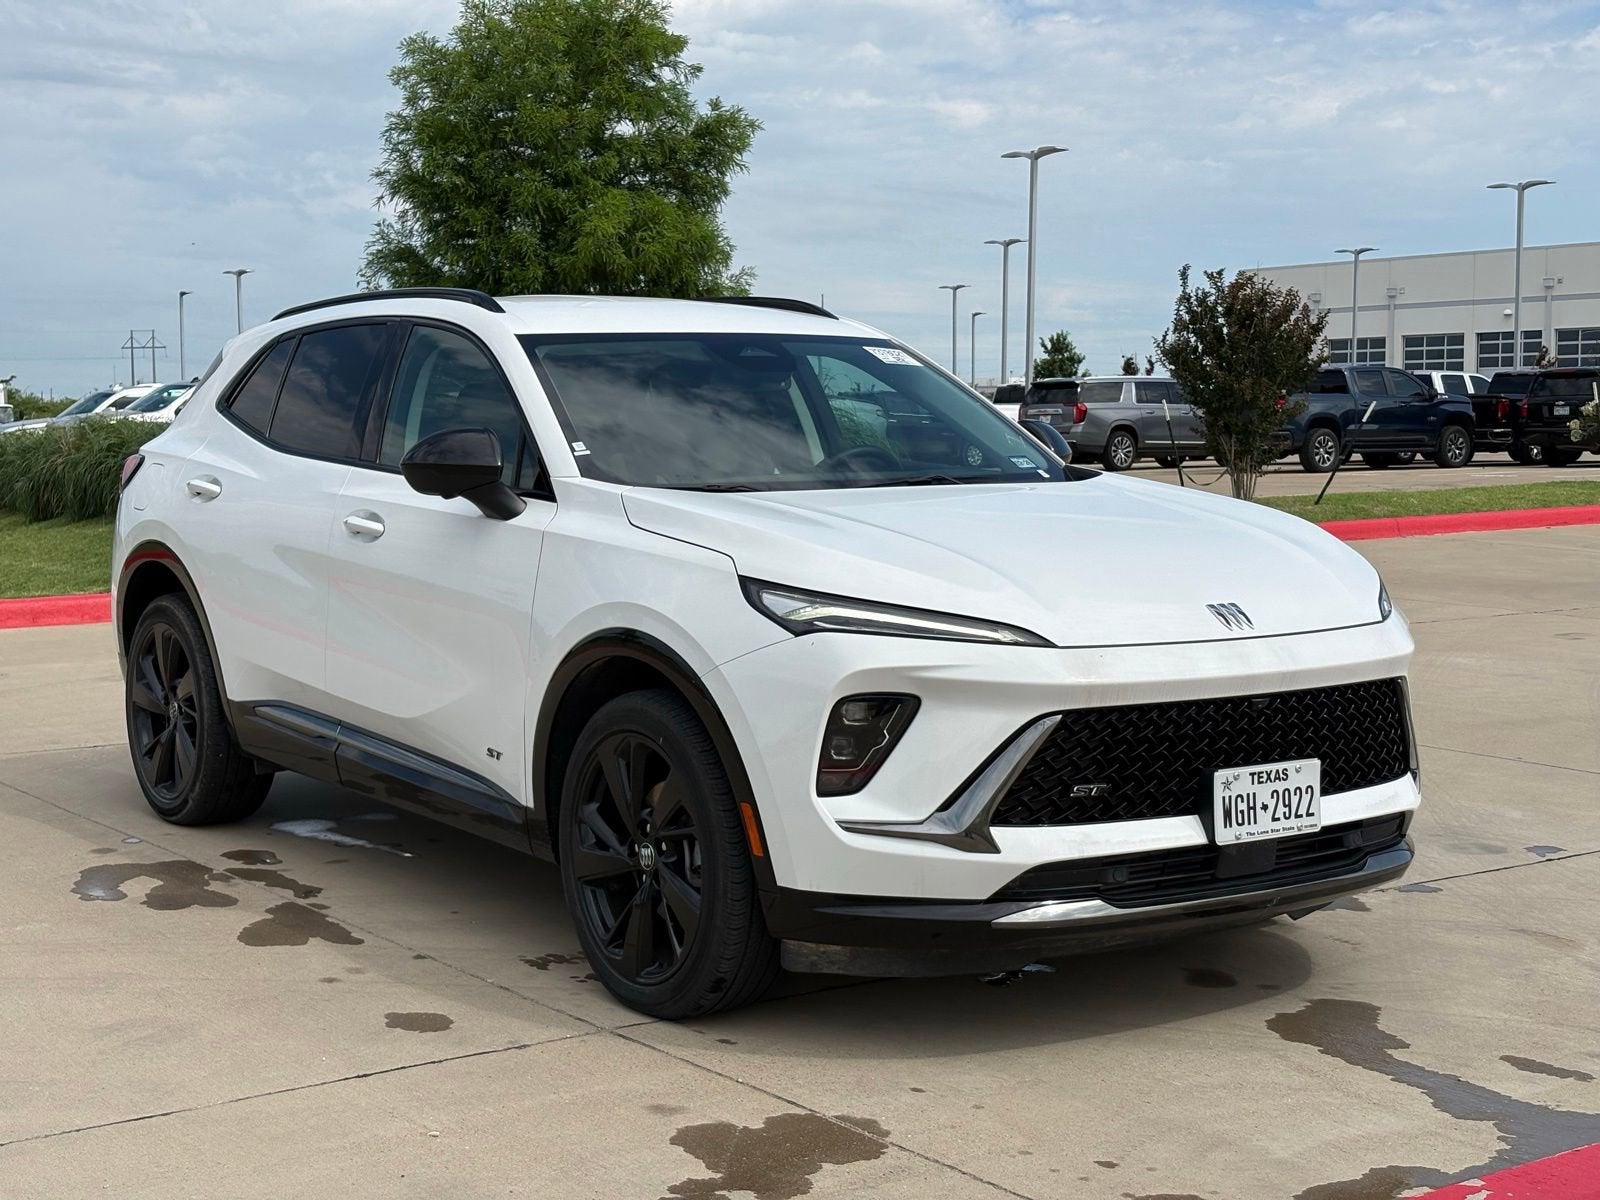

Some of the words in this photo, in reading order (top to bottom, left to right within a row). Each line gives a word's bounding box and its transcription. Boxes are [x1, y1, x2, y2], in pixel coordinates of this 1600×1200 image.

[486, 747, 503, 760] ST
[1249, 768, 1289, 785] TEXAS
[1070, 784, 1107, 796] ST
[1222, 792, 1257, 829] WGH
[1270, 785, 1315, 822] 2922
